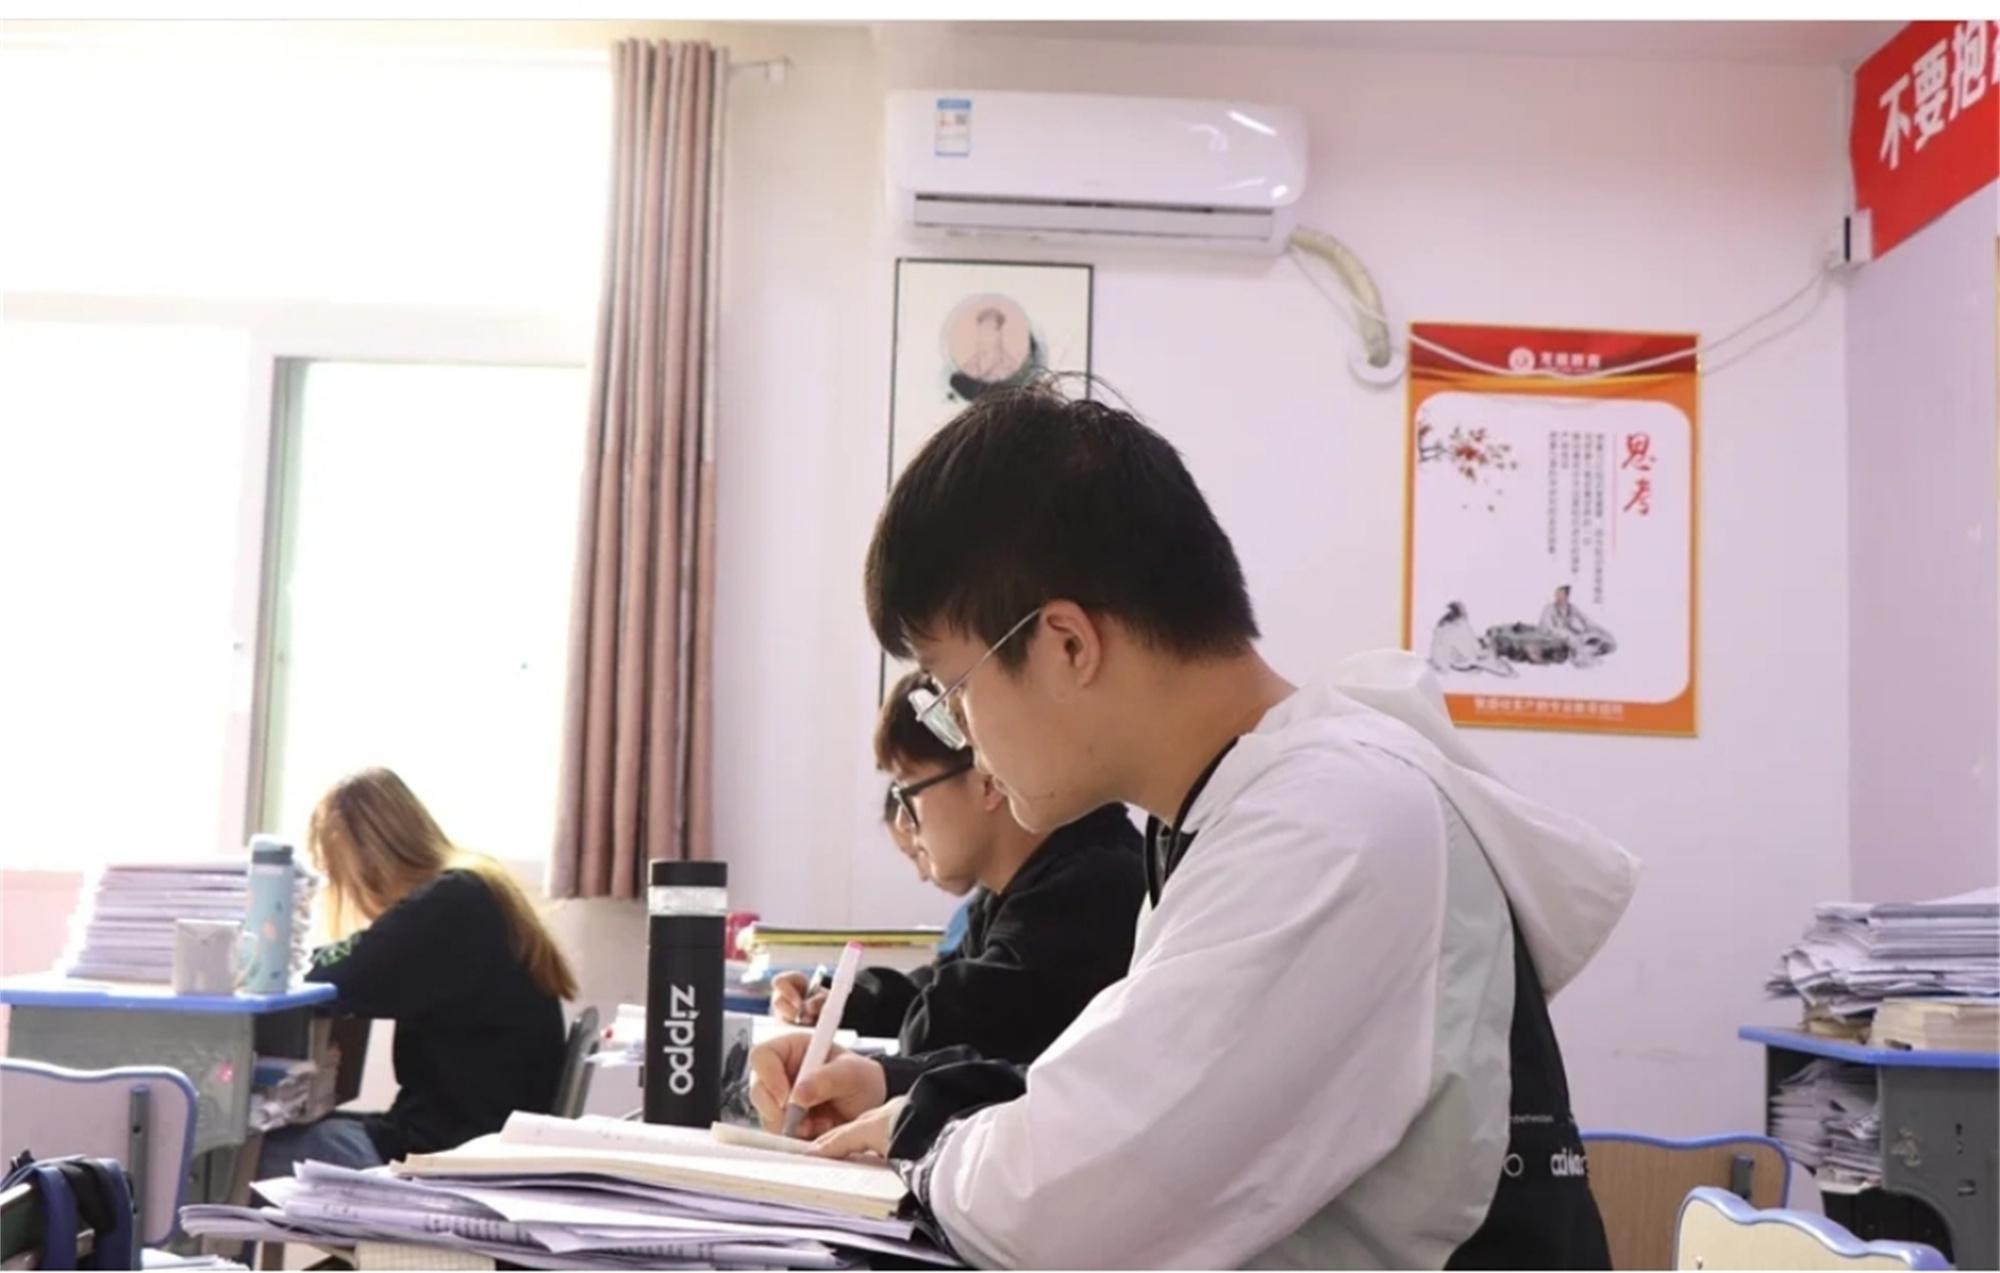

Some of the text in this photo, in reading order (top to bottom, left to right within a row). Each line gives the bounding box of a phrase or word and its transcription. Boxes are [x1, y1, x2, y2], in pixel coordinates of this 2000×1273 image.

[1879, 20, 2000, 171] 不要抱
[1621, 431, 1657, 516] 思考
[664, 984, 700, 1096] zippo
